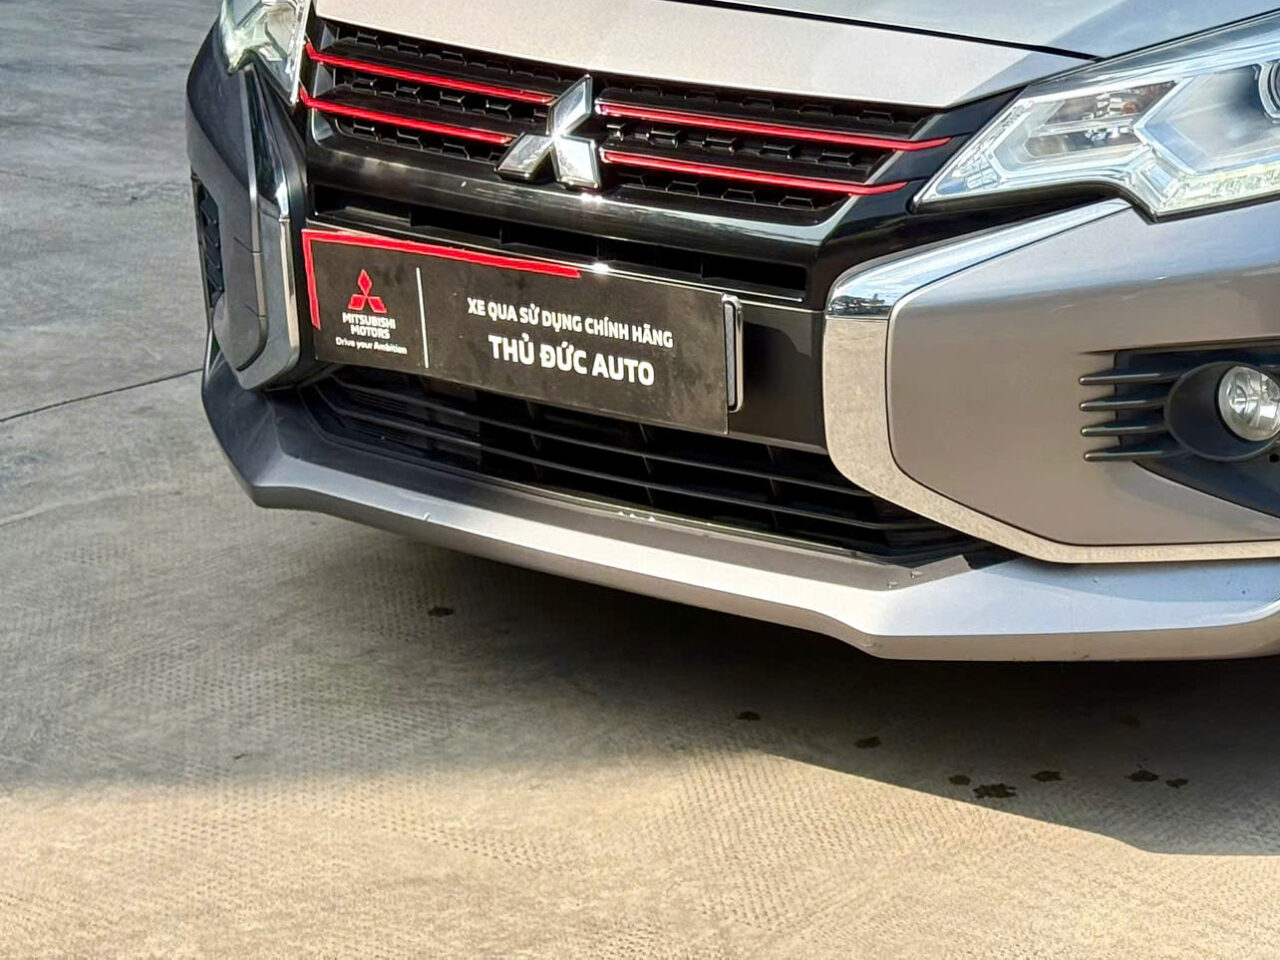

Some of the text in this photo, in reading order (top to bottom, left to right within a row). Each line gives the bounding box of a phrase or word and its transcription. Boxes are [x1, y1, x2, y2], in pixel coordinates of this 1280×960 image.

[342, 311, 396, 329] MITSUBISHI
[467, 297, 674, 348] XE QUA SỬ DỤNG CHÍNH HÃNG
[350, 325, 391, 340] MOTORS
[335, 337, 408, 355] Drive your Ambition
[488, 333, 656, 386] THỦ ĐỨC AUTO
